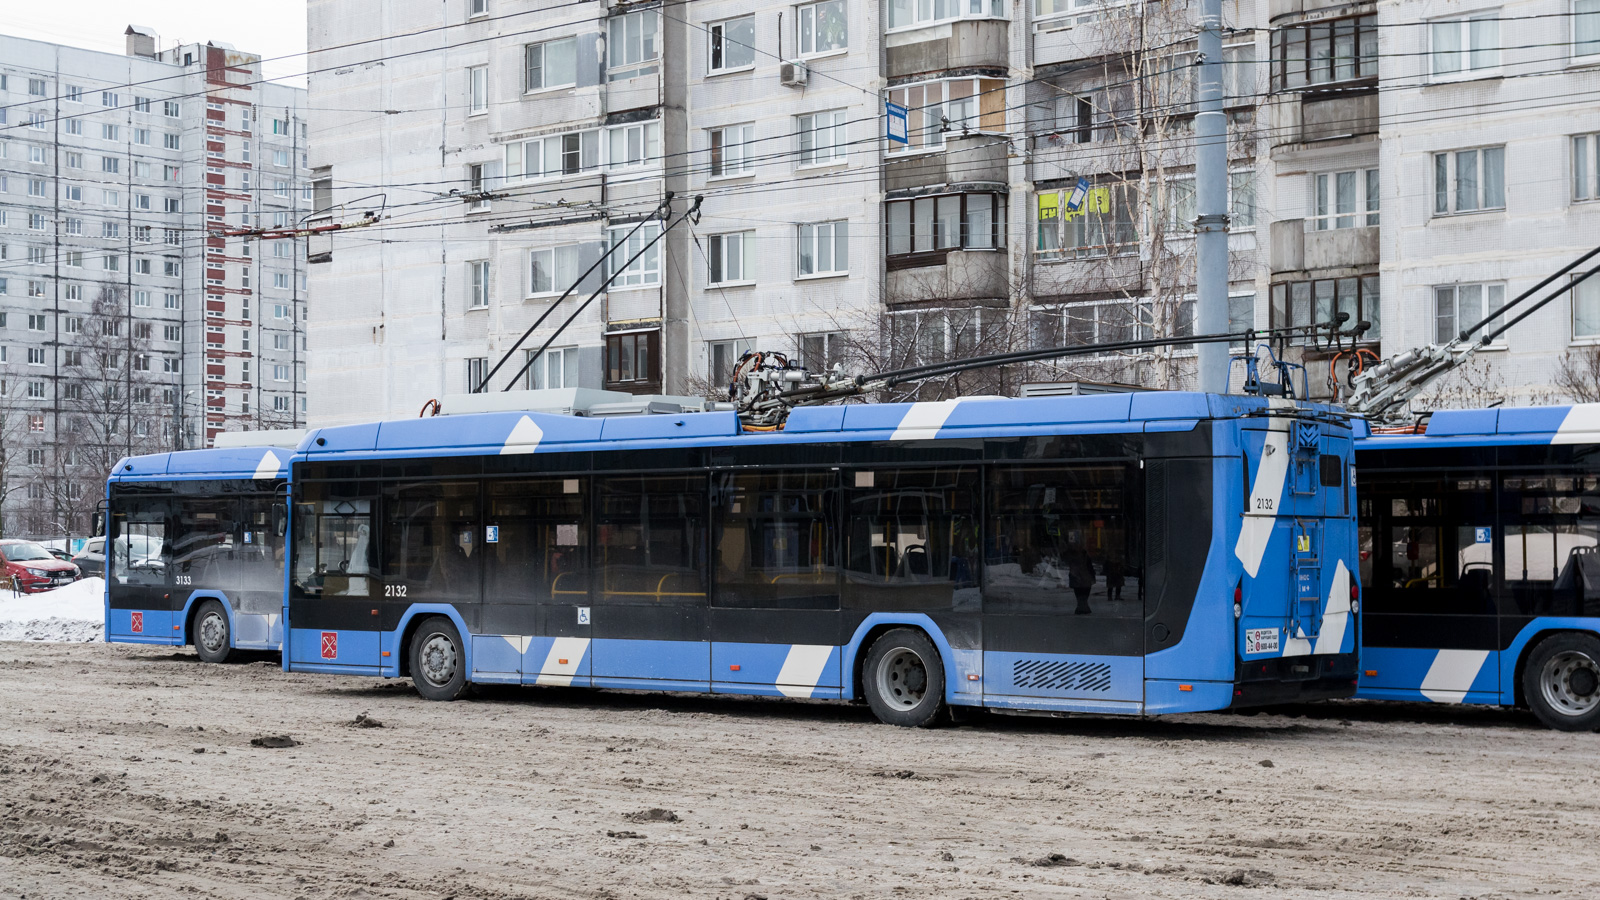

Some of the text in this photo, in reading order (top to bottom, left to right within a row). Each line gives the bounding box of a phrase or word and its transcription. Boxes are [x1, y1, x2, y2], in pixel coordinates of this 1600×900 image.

[1256, 497, 1273, 510] 2132
[175, 575, 192, 585] 3133
[384, 584, 407, 597] 2132
